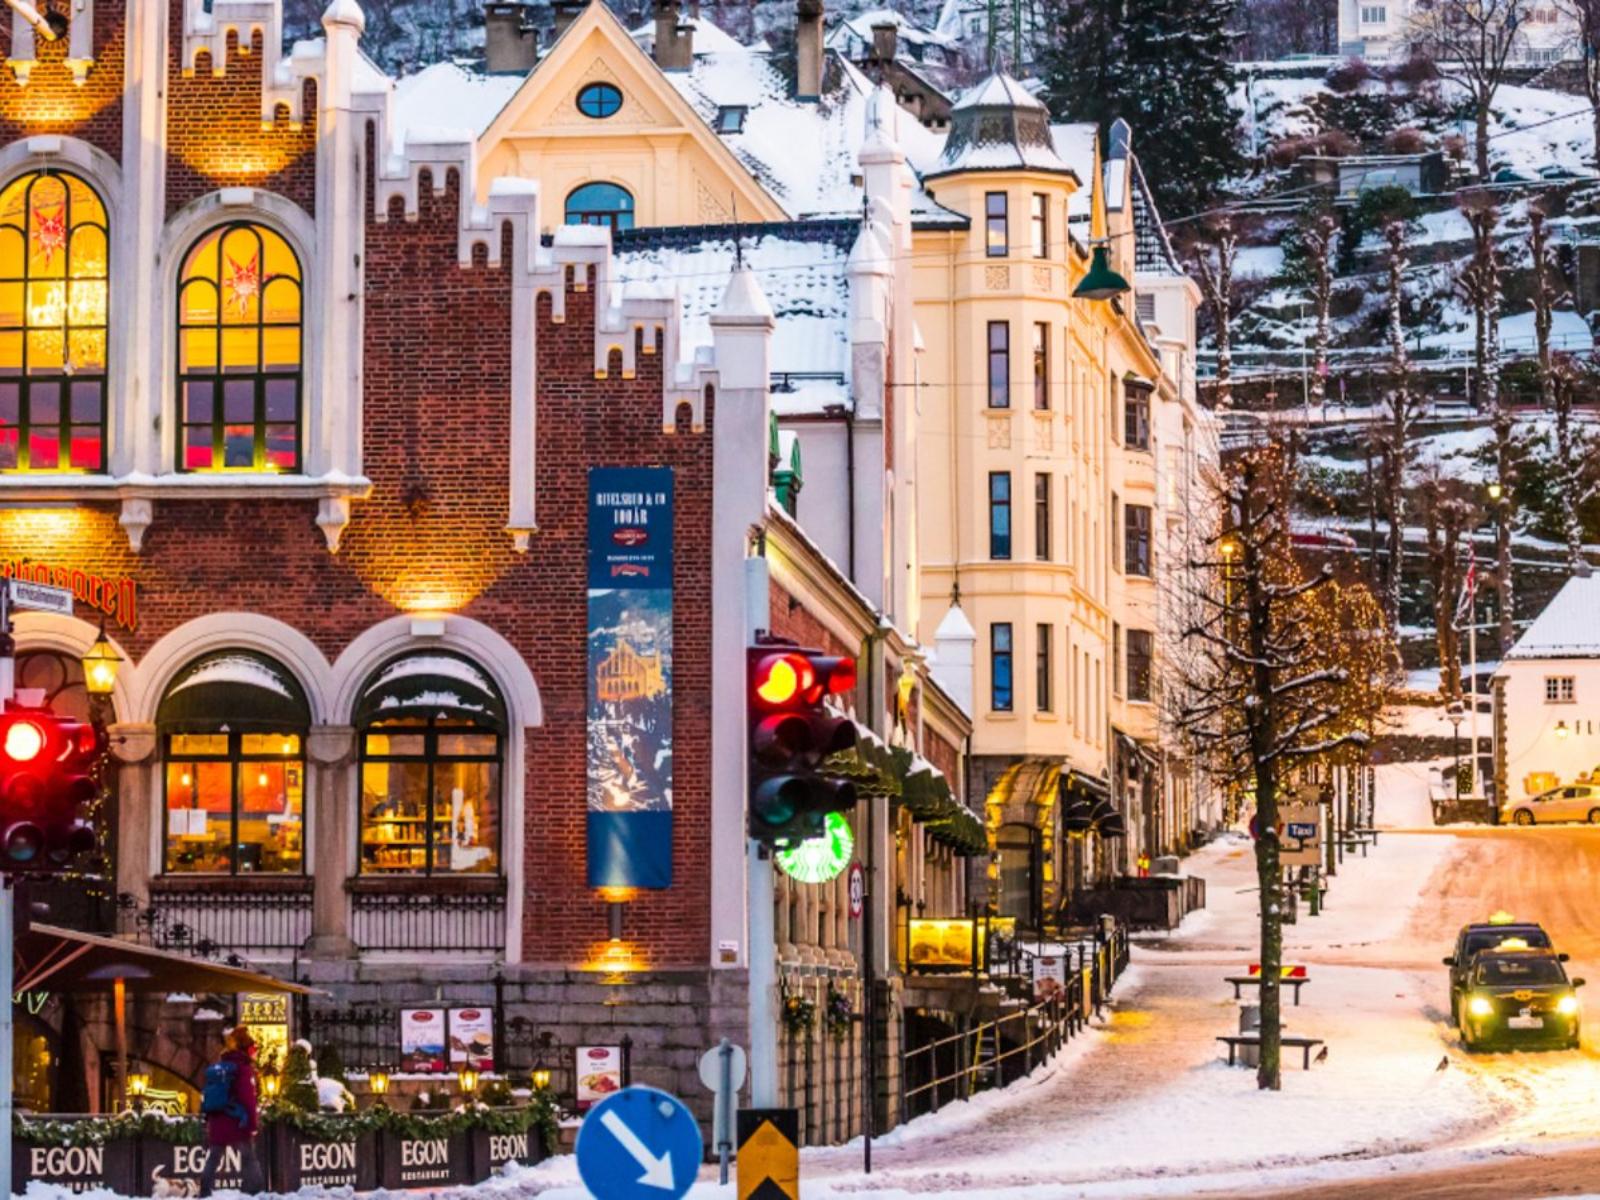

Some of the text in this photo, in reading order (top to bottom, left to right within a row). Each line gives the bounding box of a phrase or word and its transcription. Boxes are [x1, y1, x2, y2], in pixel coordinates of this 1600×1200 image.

[300, 1142, 356, 1171] EGON
[401, 1139, 448, 1166] EGON
[490, 1134, 528, 1160] EGON
[30, 1147, 104, 1176] EGON
[402, 1169, 449, 1180] RESTAURANT
